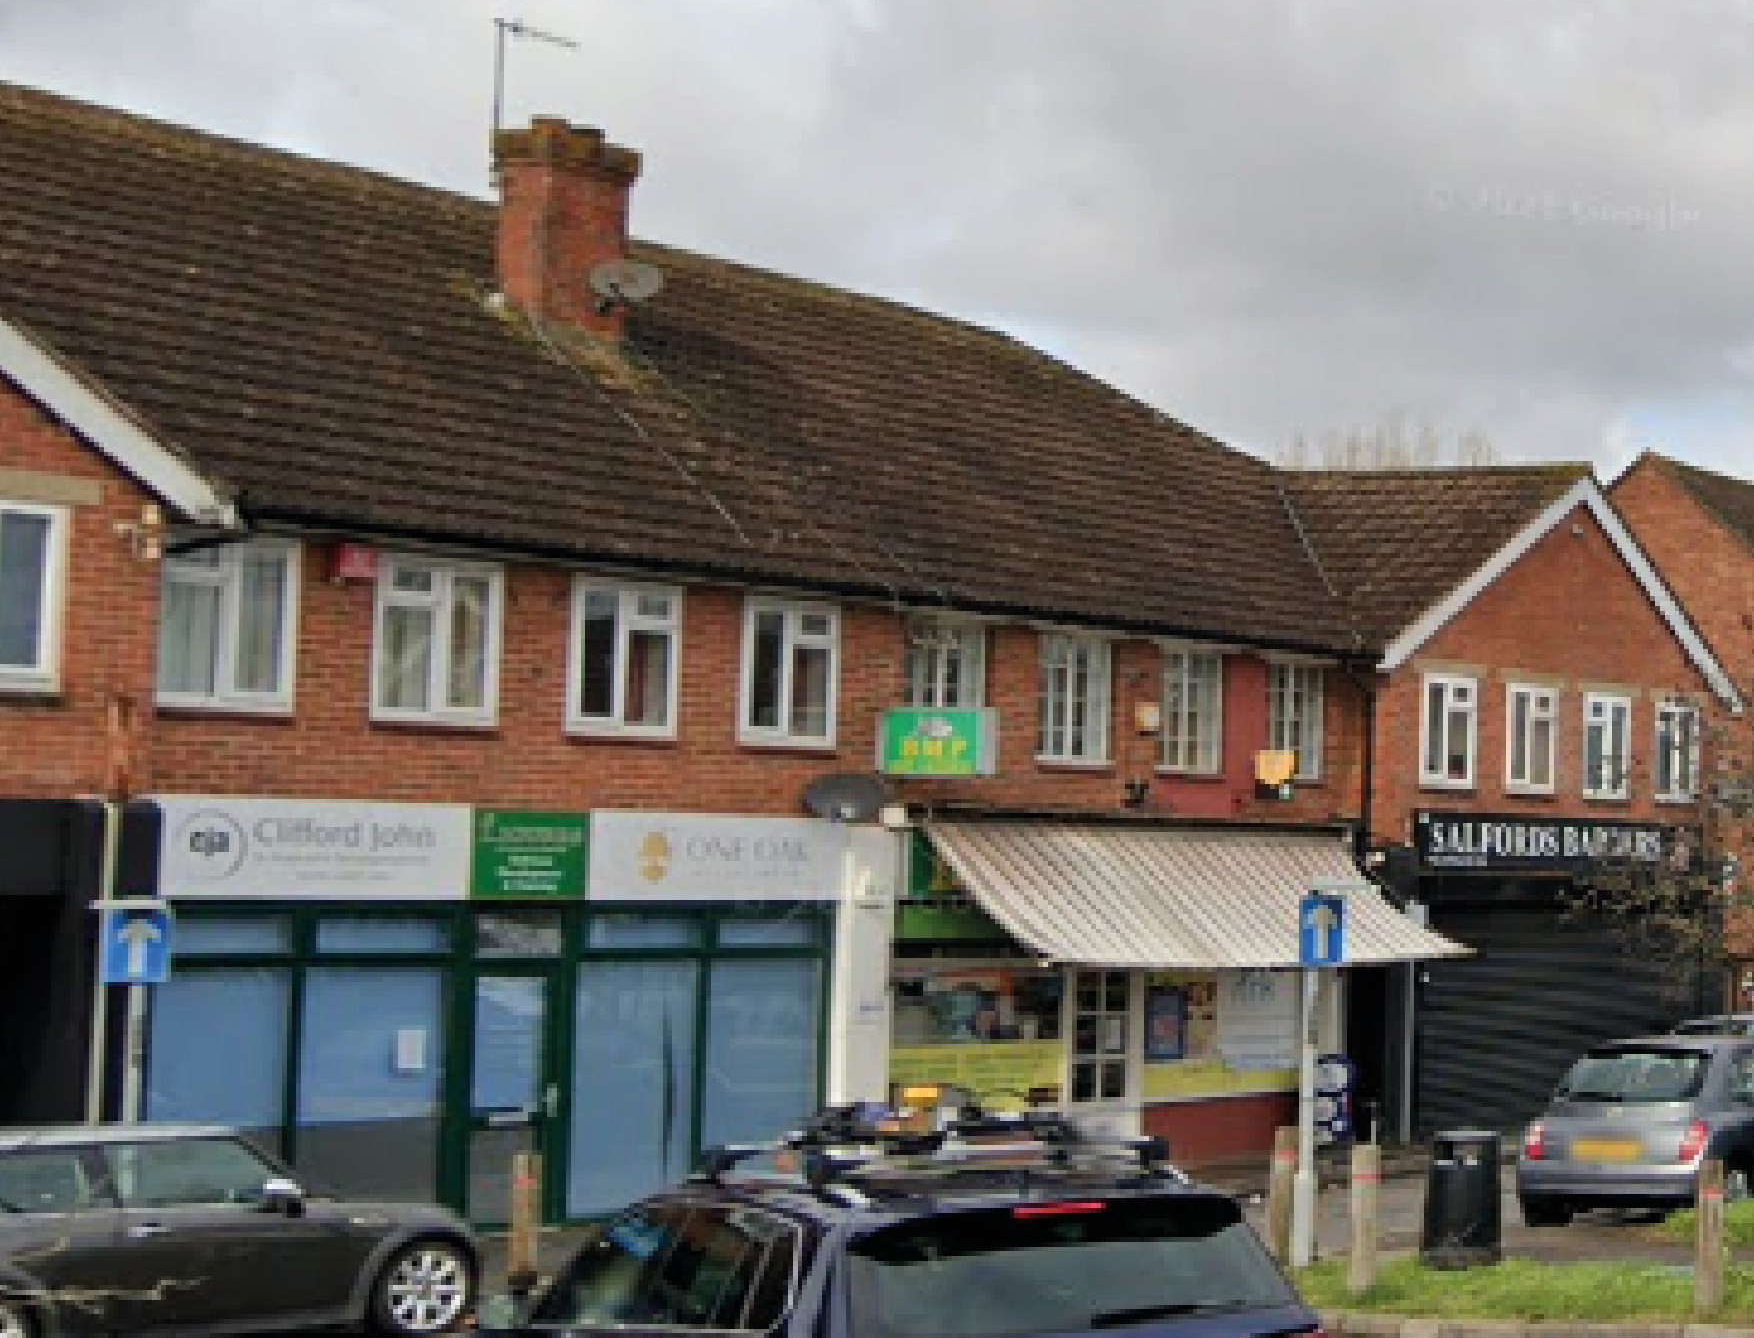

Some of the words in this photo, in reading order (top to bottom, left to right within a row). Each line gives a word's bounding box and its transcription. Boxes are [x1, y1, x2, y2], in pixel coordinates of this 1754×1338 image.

[252, 816, 361, 848] Clifford
[368, 821, 438, 853] John
[1428, 821, 1561, 858] SALFORDS
